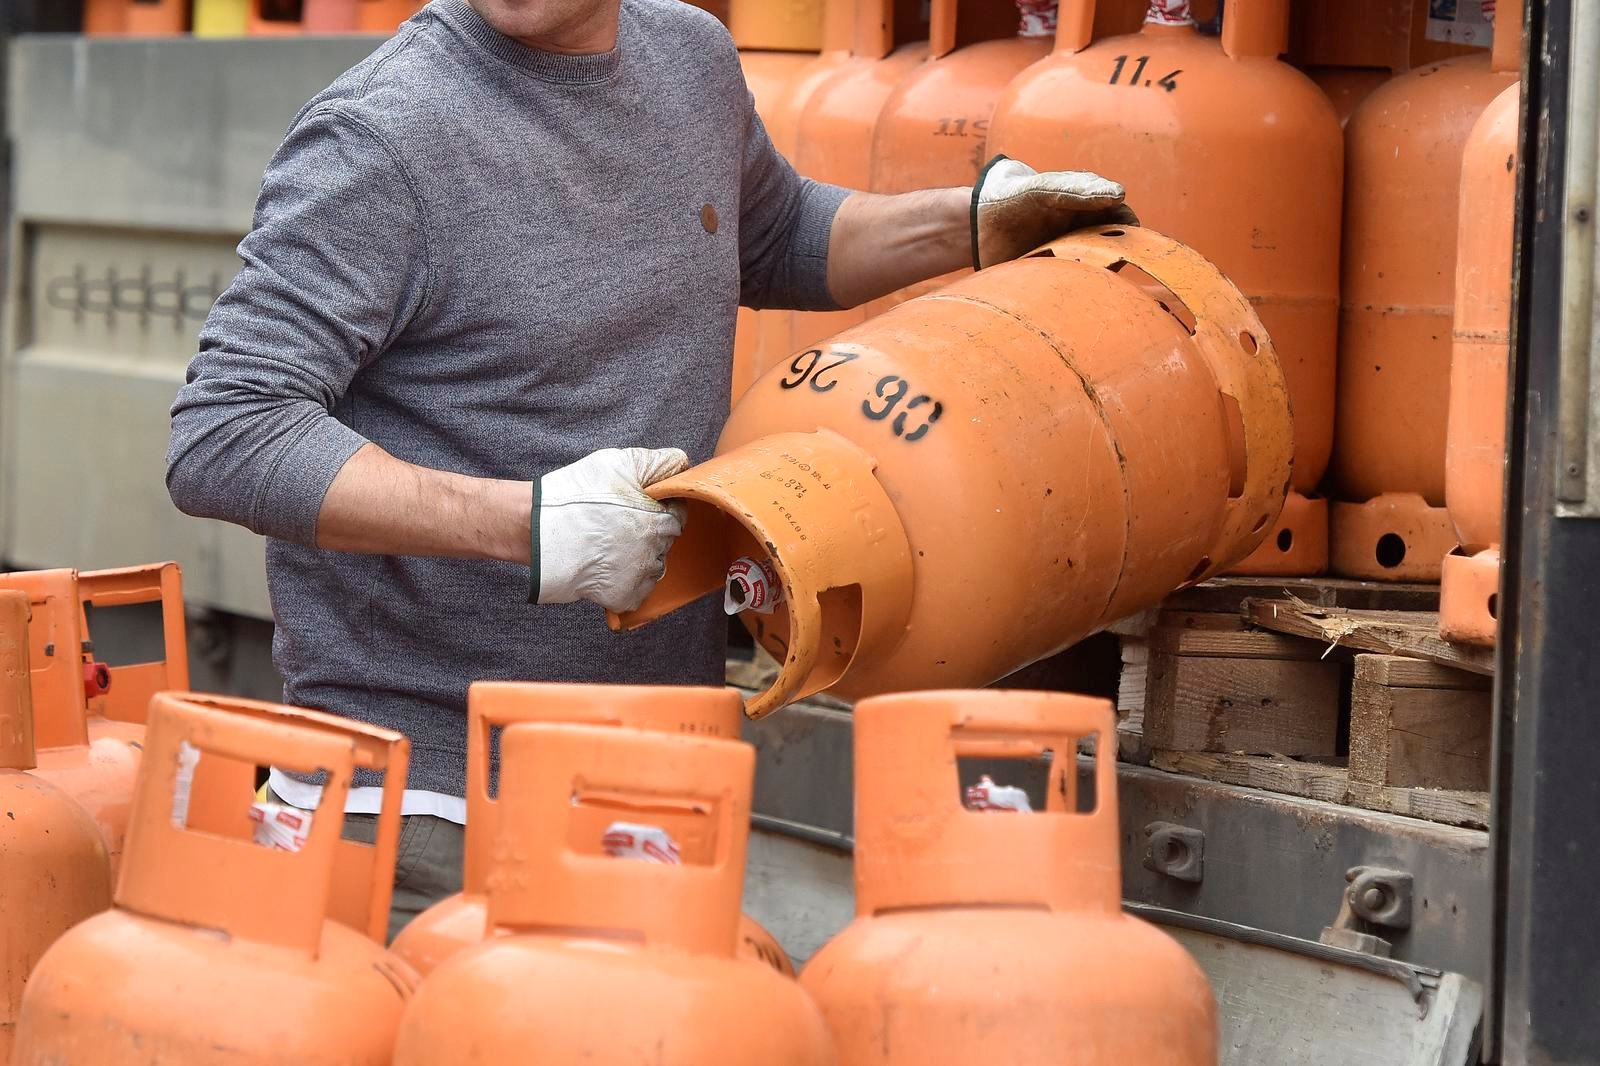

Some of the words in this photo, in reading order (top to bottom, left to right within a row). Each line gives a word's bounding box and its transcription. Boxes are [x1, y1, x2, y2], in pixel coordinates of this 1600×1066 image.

[1109, 55, 1183, 92] 11.4
[780, 349, 859, 392] 26
[862, 374, 943, 441] 06
